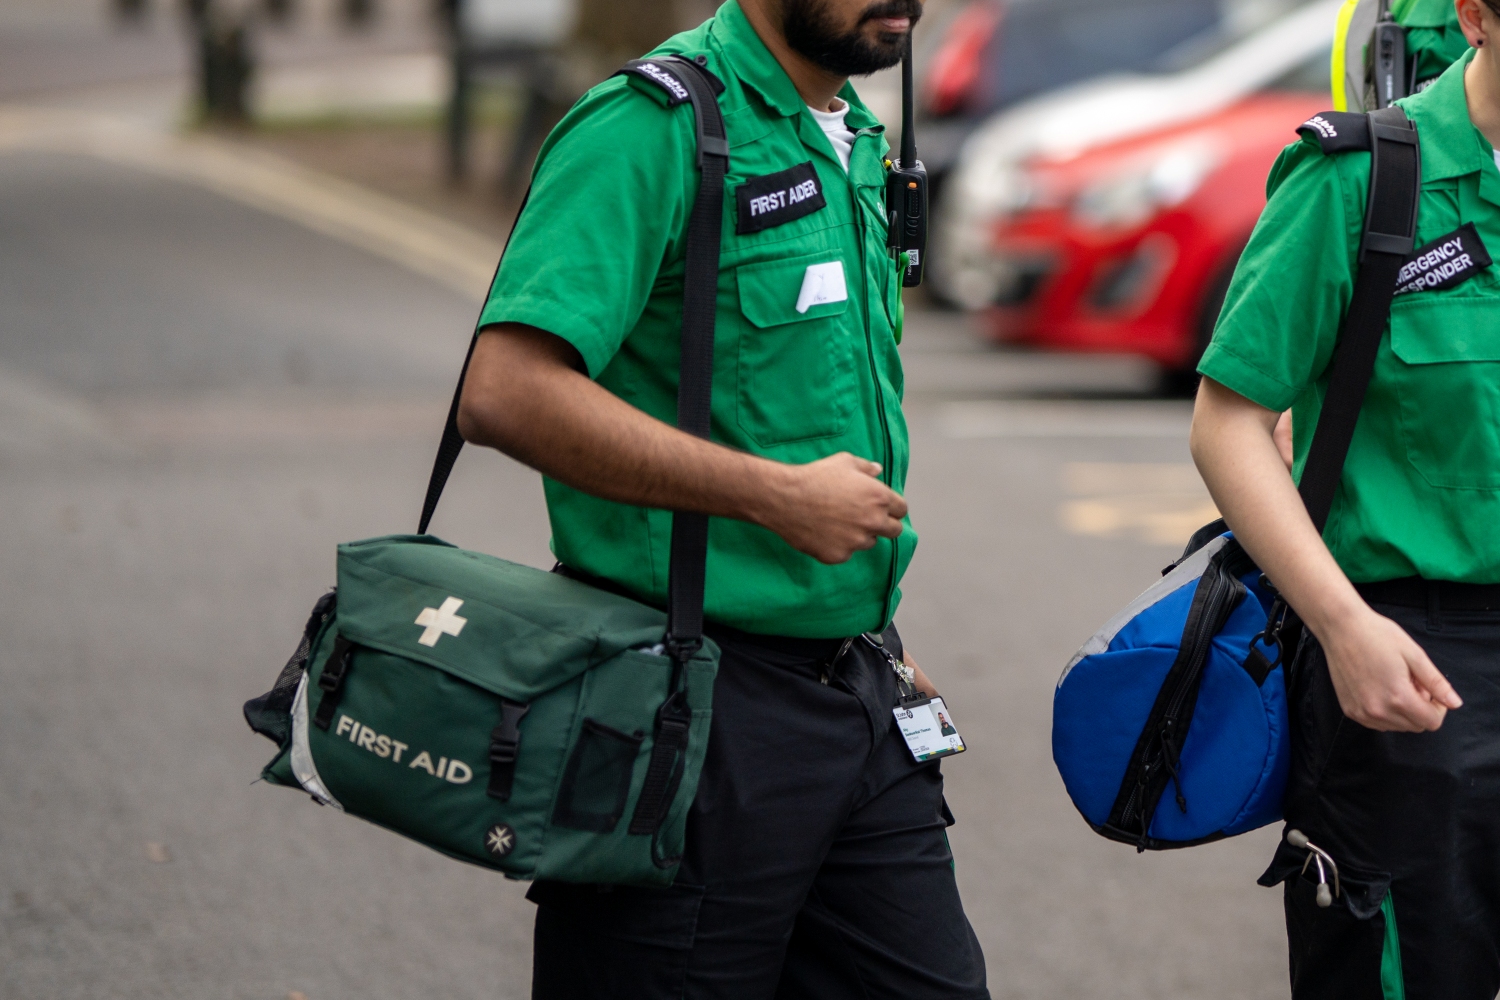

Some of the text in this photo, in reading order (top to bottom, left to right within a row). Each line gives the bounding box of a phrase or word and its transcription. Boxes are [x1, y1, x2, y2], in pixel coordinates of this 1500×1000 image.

[750, 180, 818, 216] FIRST AIDER
[1396, 236, 1463, 287] MERGENCY
[336, 714, 473, 785] FIRST AID
